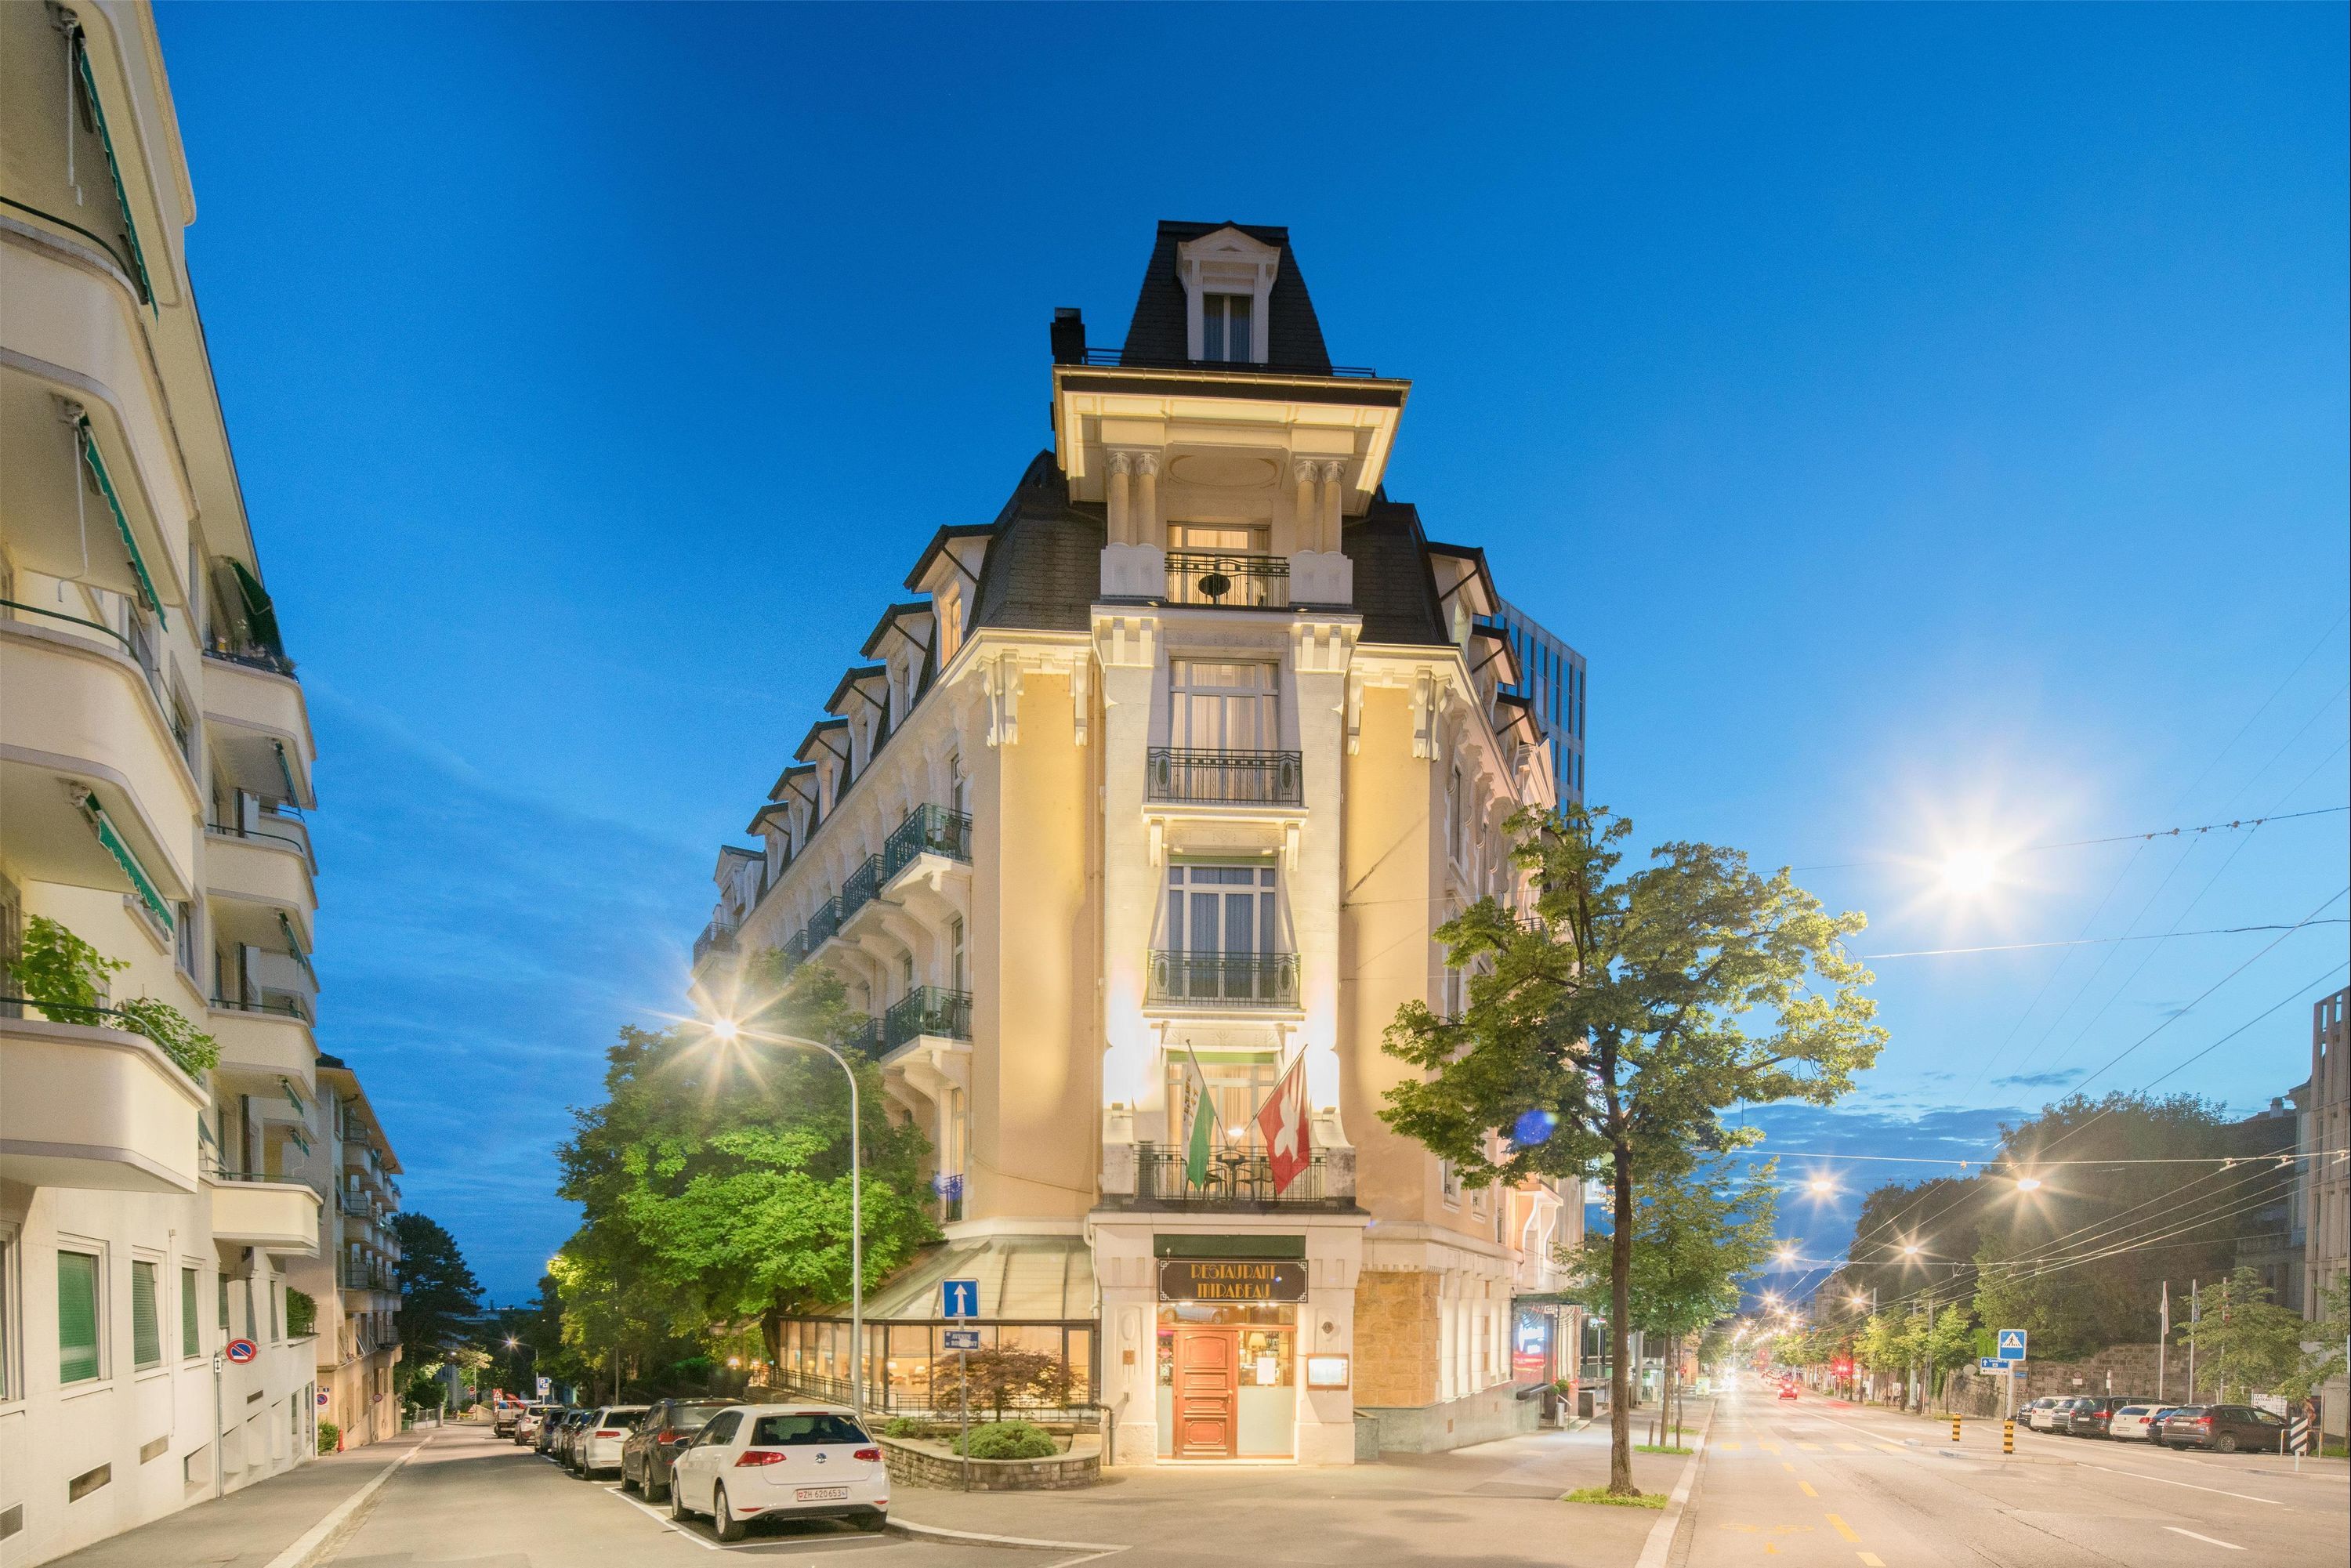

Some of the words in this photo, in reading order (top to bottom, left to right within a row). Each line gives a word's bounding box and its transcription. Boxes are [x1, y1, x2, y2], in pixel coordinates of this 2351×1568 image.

[1190, 1264, 1277, 1279] RESTAURANT
[1197, 1283, 1270, 1298] MIRABEAU
[803, 1490, 813, 1499] ZH
